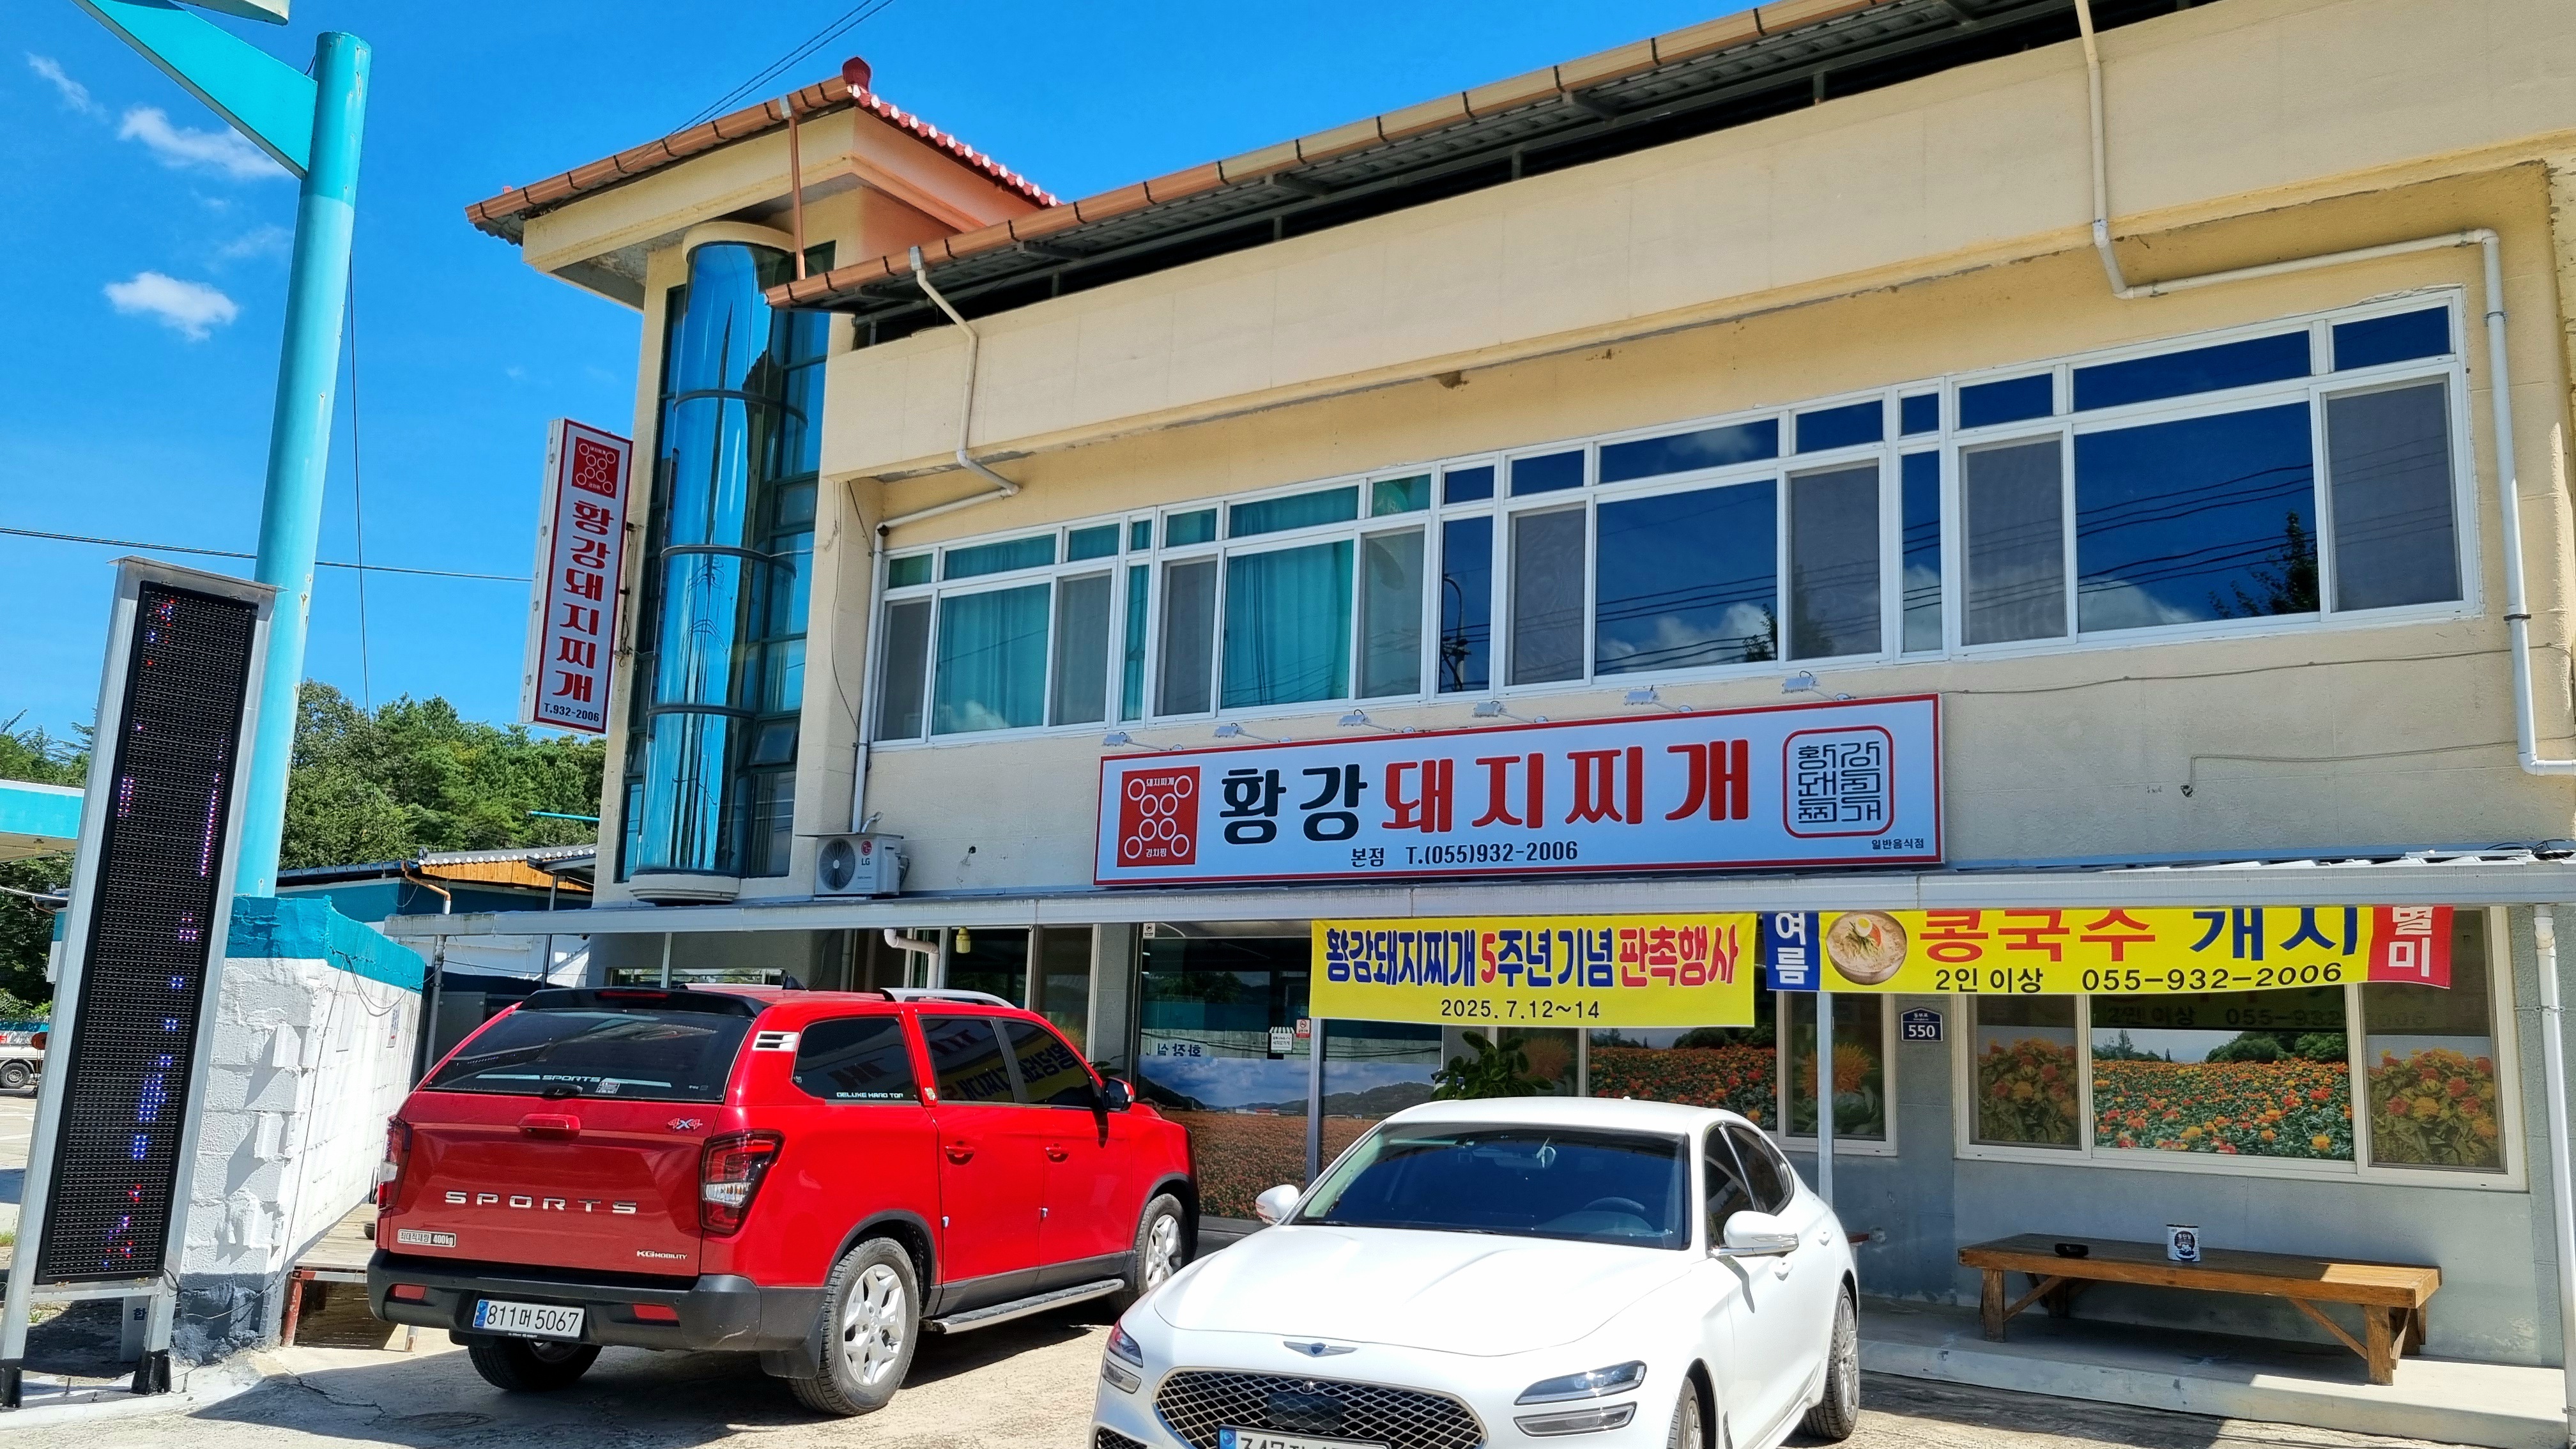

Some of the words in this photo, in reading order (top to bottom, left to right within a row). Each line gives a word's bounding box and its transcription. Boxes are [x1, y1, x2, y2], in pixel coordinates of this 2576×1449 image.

[553, 500, 615, 703] 황강돼지찌개
[544, 703, 599, 722] T.932-2006
[1220, 739, 1750, 844] 황강돼지찌개
[1351, 847, 1384, 867] 본점
[1871, 838, 1924, 850] 일반음식점
[1920, 909, 2156, 963] 콩국수
[2189, 907, 2357, 962] 개시
[2388, 907, 2433, 977] 별미
[1775, 912, 1809, 985] 여름
[1936, 969, 1977, 992] 2인
[1990, 968, 2043, 993] 이상
[2082, 963, 2342, 990] 055-932-2006
[1908, 1025, 1935, 1038] 550
[445, 1192, 637, 1215] SPORTS
[433, 1234, 454, 1246] 400kg
